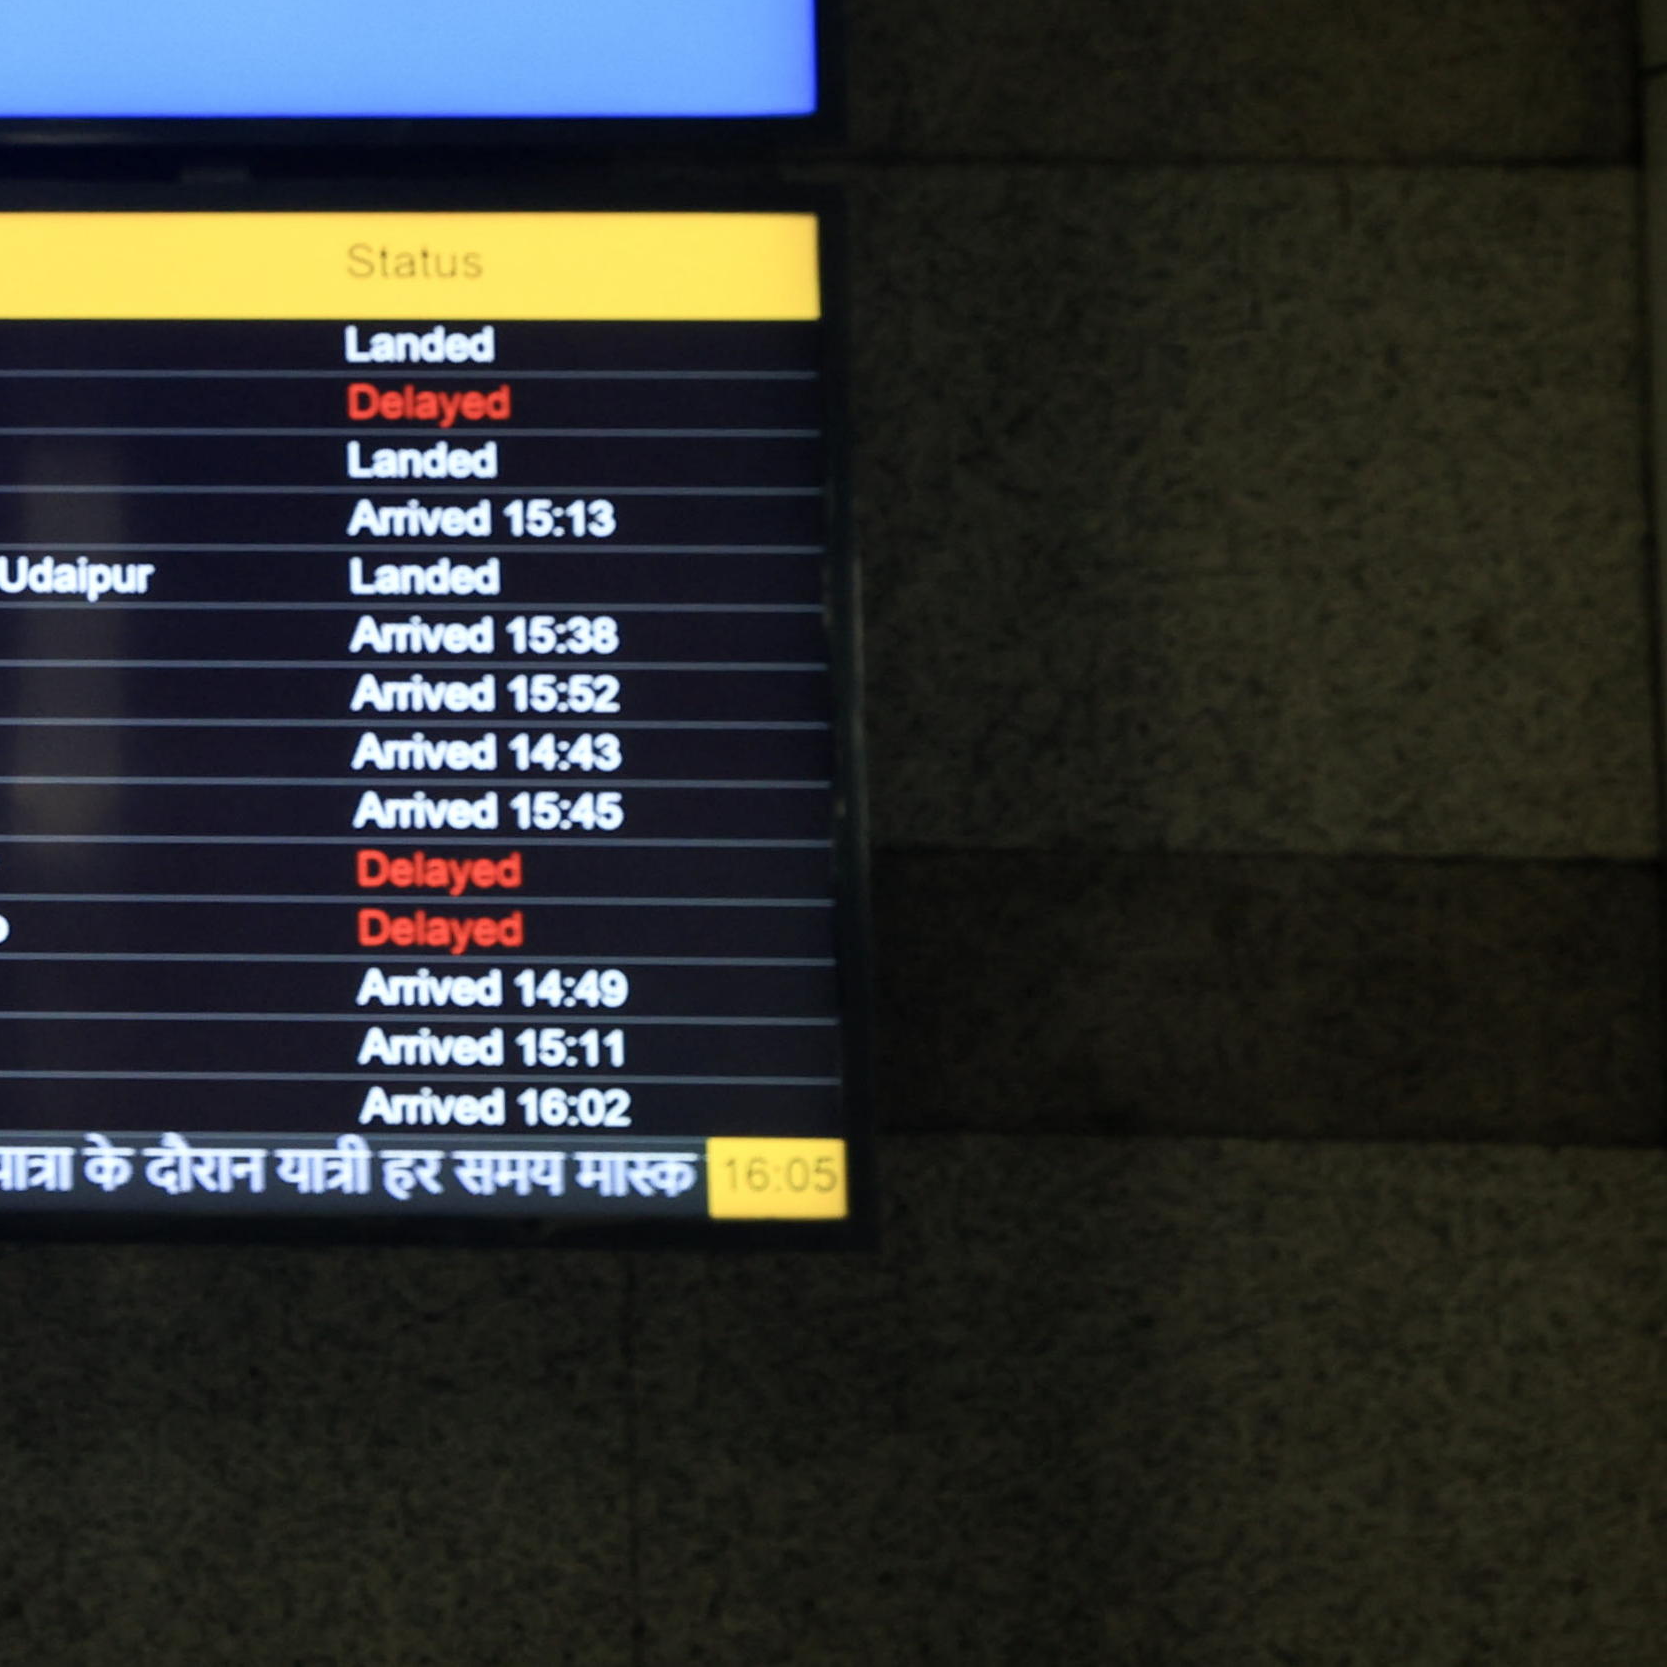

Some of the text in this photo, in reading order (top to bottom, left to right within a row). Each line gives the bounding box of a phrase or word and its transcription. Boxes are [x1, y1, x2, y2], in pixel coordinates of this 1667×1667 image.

[347, 242, 485, 280] Status
[346, 326, 494, 362] Landed
[349, 384, 510, 427] Delayed
[348, 442, 497, 478] Landed
[348, 500, 615, 536] Arrived 15:13
[350, 558, 499, 594] Landed
[350, 616, 618, 653] Arrived 15:38
[351, 674, 620, 712] Arrived 15:52
[352, 733, 621, 770] Arrived 14:43
[353, 791, 623, 829] Arrived 15:45
[358, 850, 521, 896] Delayed
[359, 909, 523, 954] Delayed
[357, 968, 628, 1007] Arrived 14:49
[359, 1027, 623, 1066] Arrived 15:11
[360, 1087, 631, 1126] Arrived 16:02
[81, 1132, 137, 1192] के
[141, 1131, 268, 1194] दौरान
[273, 1132, 372, 1195] यात्री
[378, 1149, 446, 1201] हर
[450, 1150, 567, 1196] समय
[572, 1150, 699, 1197] मास्क
[724, 1157, 839, 1194] 16:05
